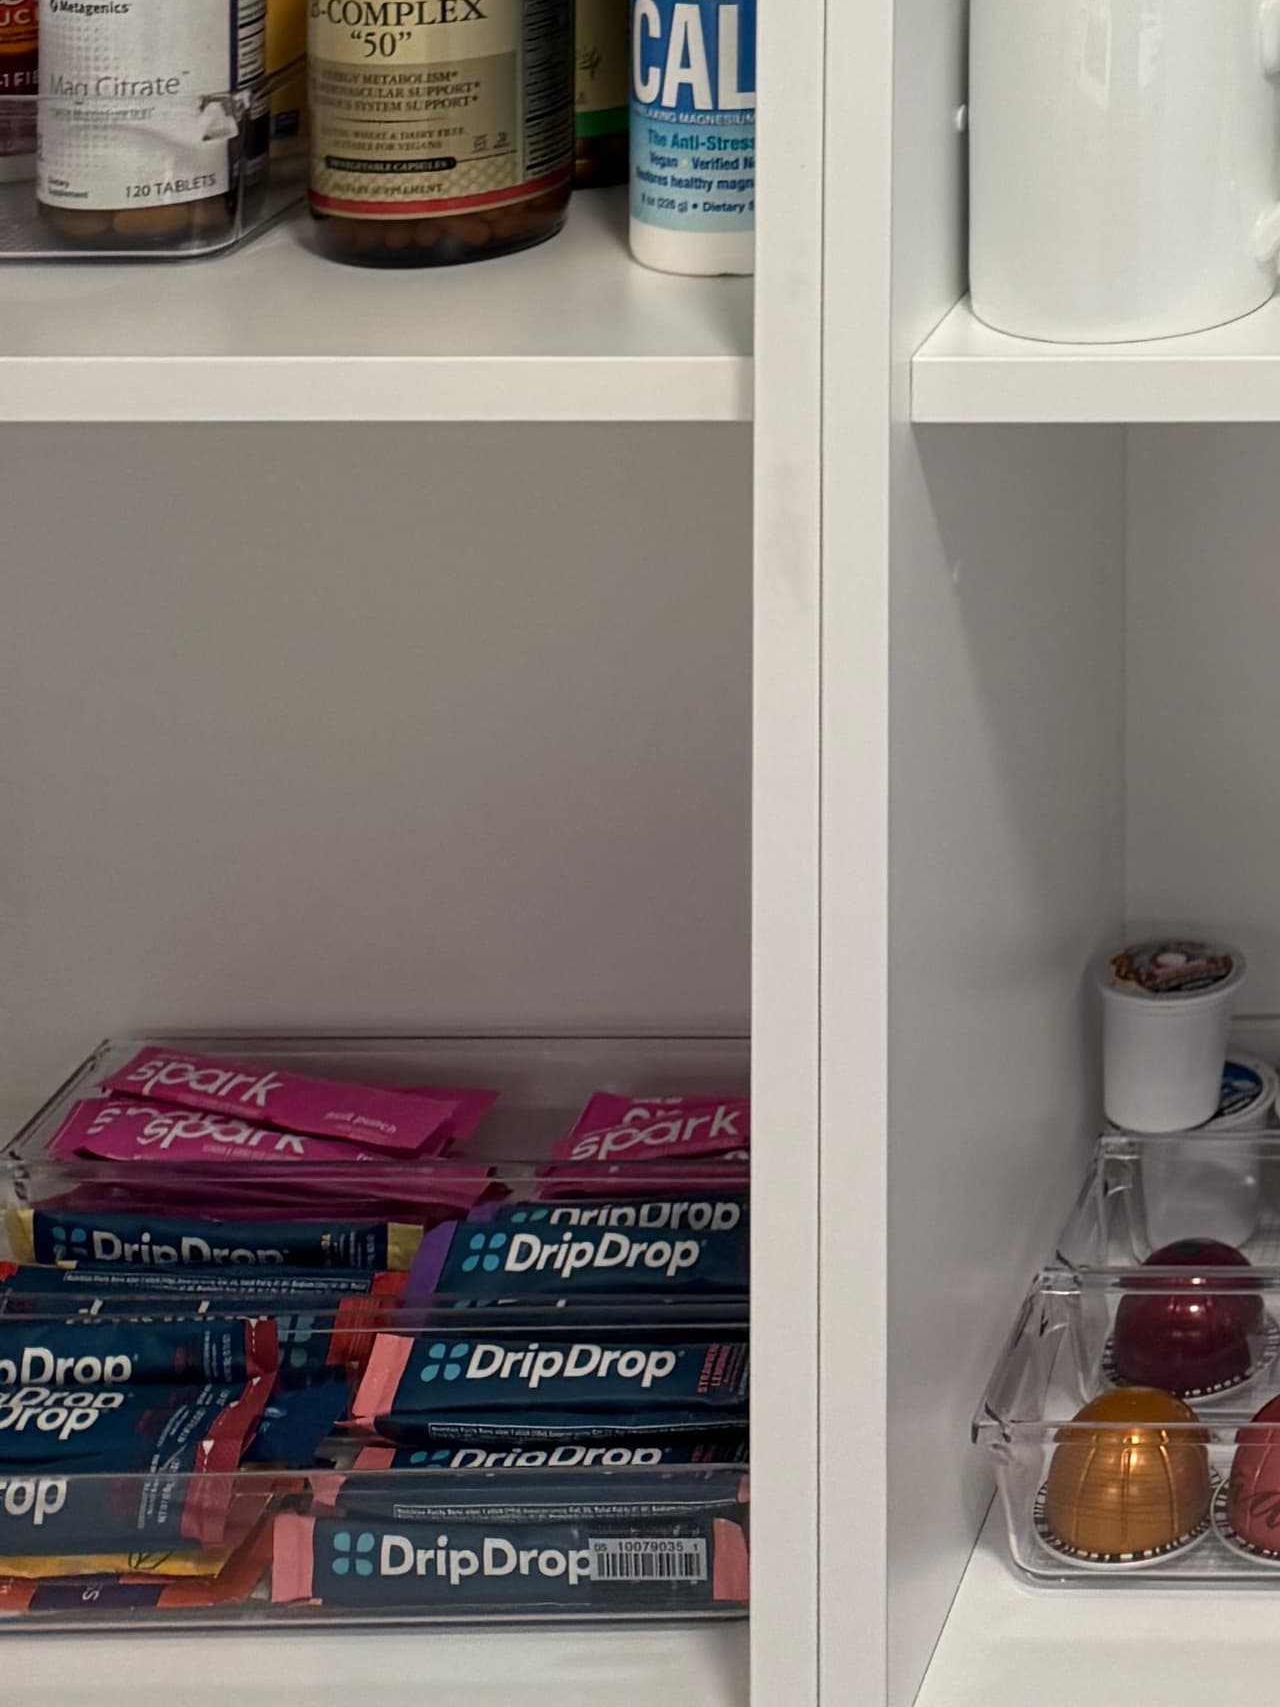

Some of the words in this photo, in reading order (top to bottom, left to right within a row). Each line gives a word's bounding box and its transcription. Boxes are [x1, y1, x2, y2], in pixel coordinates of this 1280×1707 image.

[58, 0, 131, 17] Metagenics
[95, 73, 181, 97] Citrate
[125, 184, 151, 199] 120
[153, 174, 217, 196] TABLETS
[126, 1058, 284, 1109] spark
[569, 1104, 743, 1161] spark
[91, 1229, 288, 1267] DripDrop
[503, 1230, 701, 1279] DripDrop
[465, 1343, 677, 1389] DripDrop
[380, 1533, 593, 1586] DripDrop
